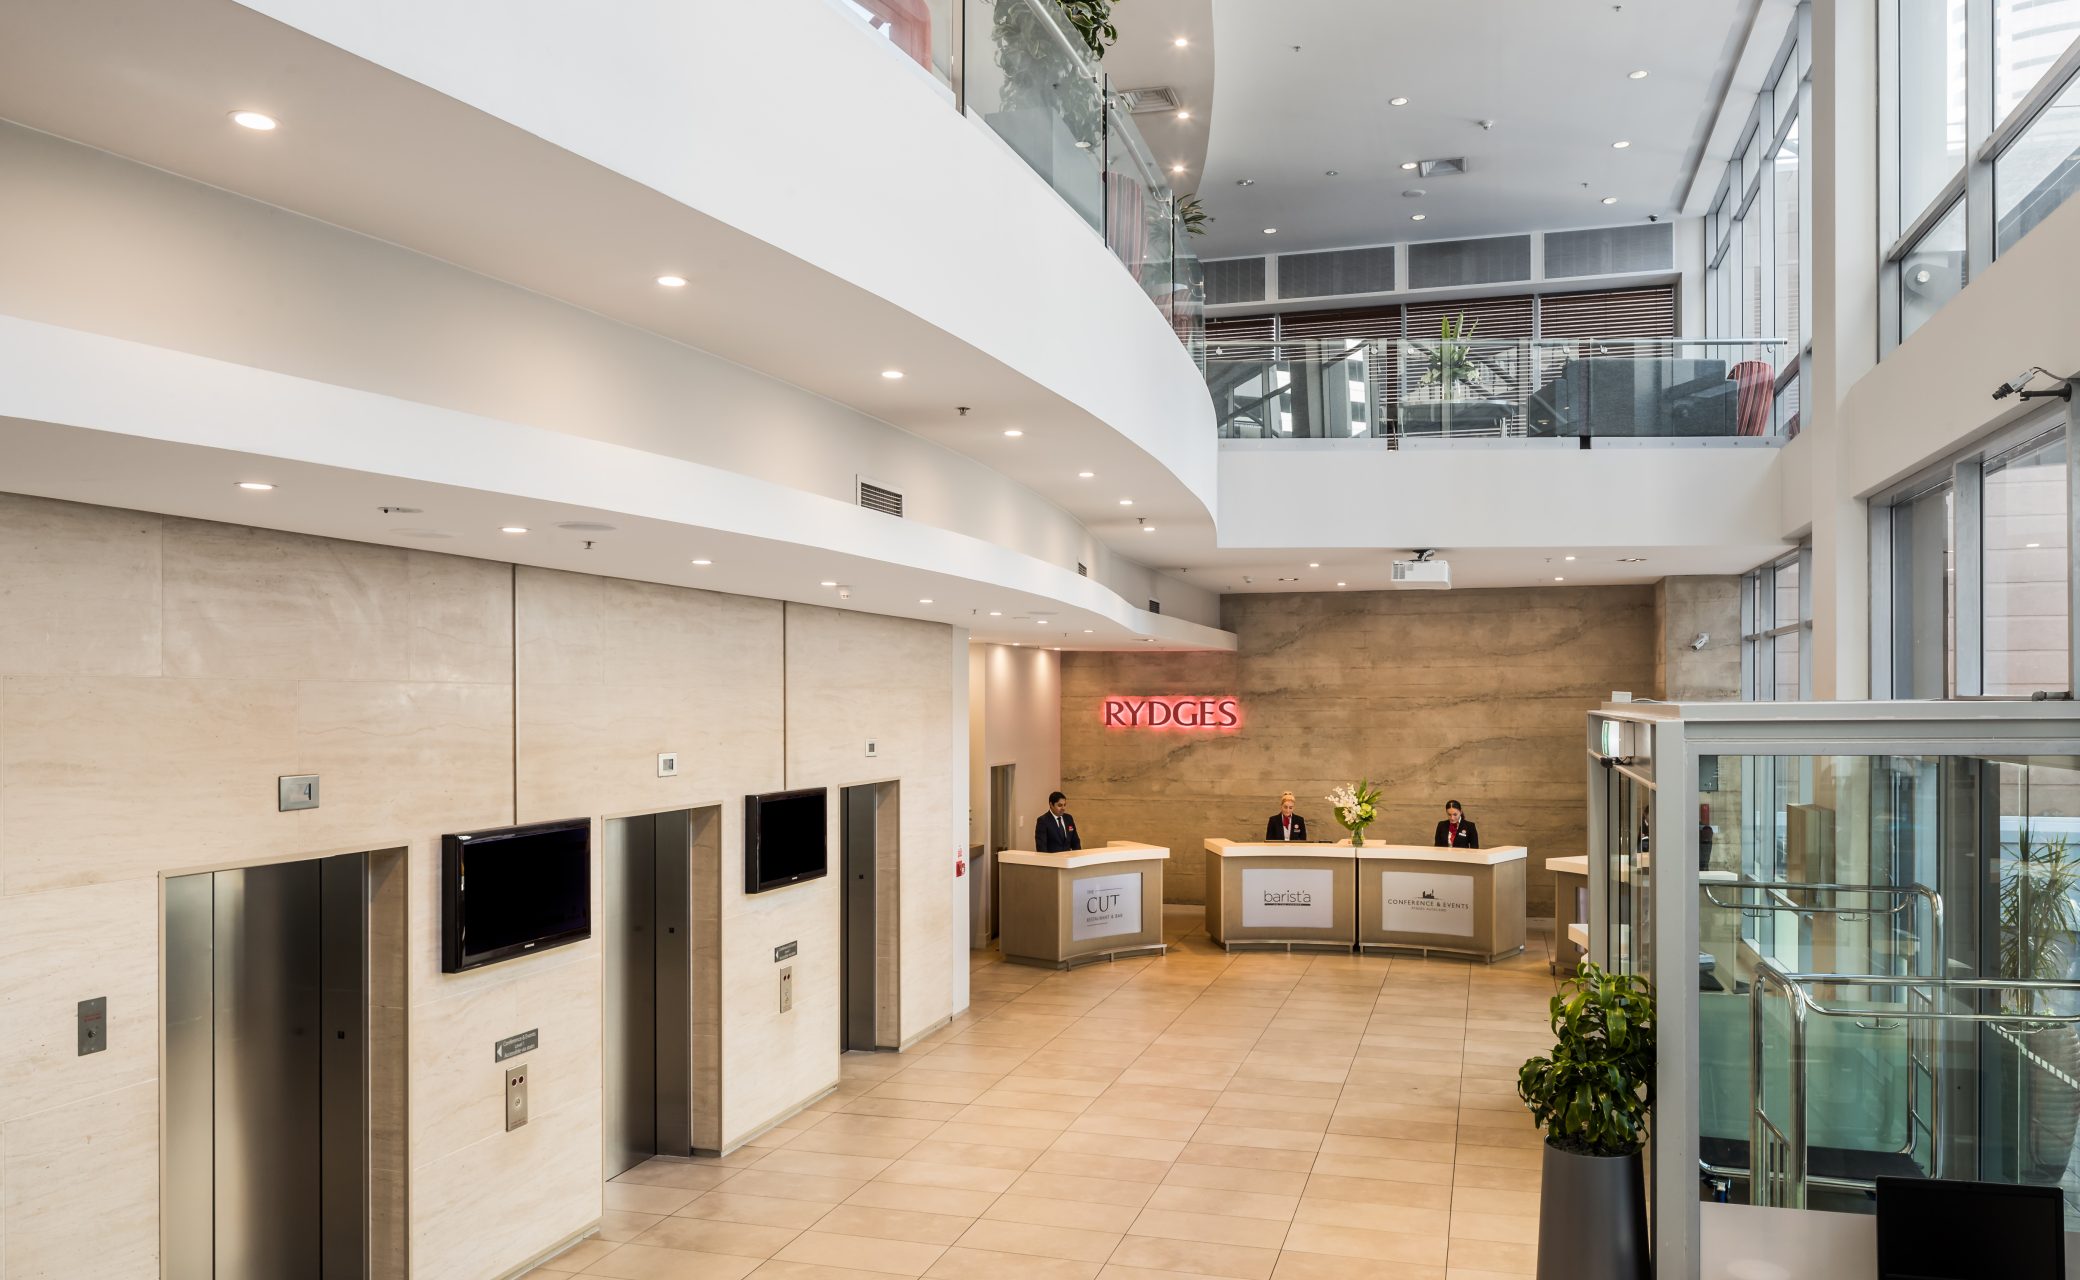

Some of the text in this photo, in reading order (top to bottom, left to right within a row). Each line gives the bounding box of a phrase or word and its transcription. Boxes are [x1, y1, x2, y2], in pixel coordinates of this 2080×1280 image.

[1105, 701, 1237, 726] RYDGES
[1086, 894, 1120, 914] CUT
[1388, 899, 1434, 907] CONFERENCE
[1443, 901, 1469, 910] EVENTS
